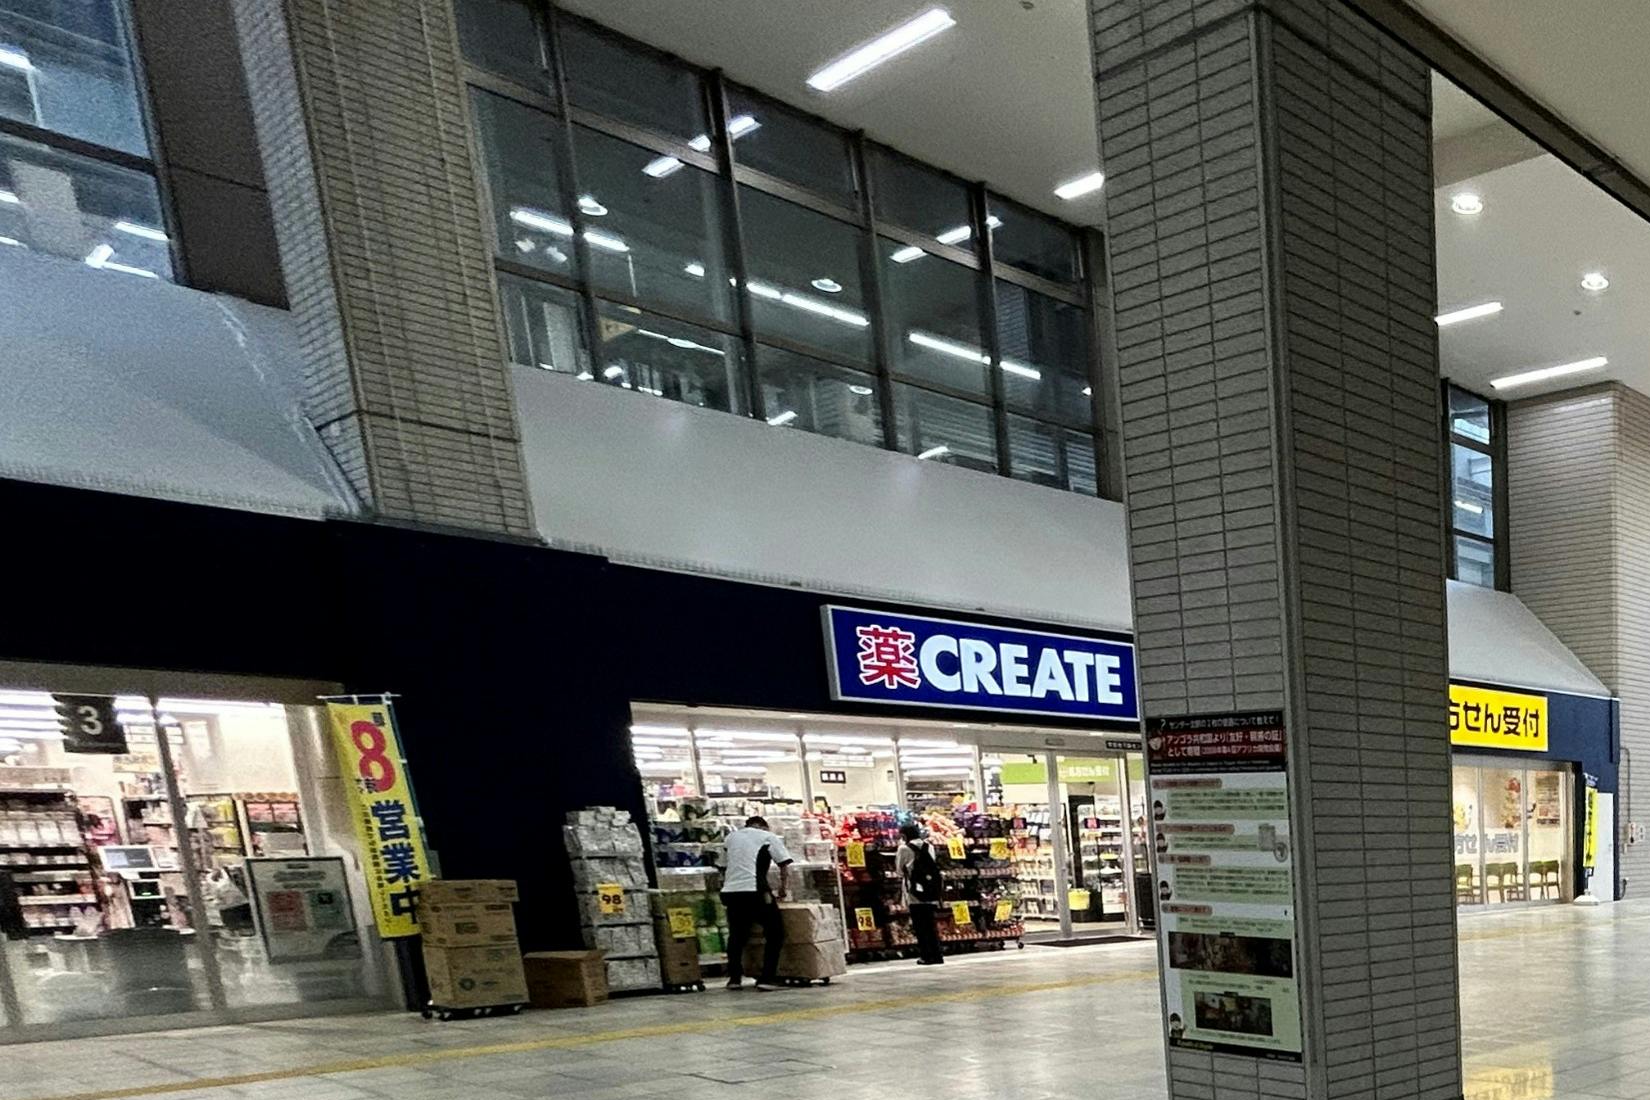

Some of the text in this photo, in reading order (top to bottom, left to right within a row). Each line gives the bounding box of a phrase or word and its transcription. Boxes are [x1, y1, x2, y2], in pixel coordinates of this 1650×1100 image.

[857, 625, 1123, 704] 薬 CREATE
[79, 705, 103, 735] 3
[602, 894, 622, 905] 98
[858, 915, 873, 927] 98
